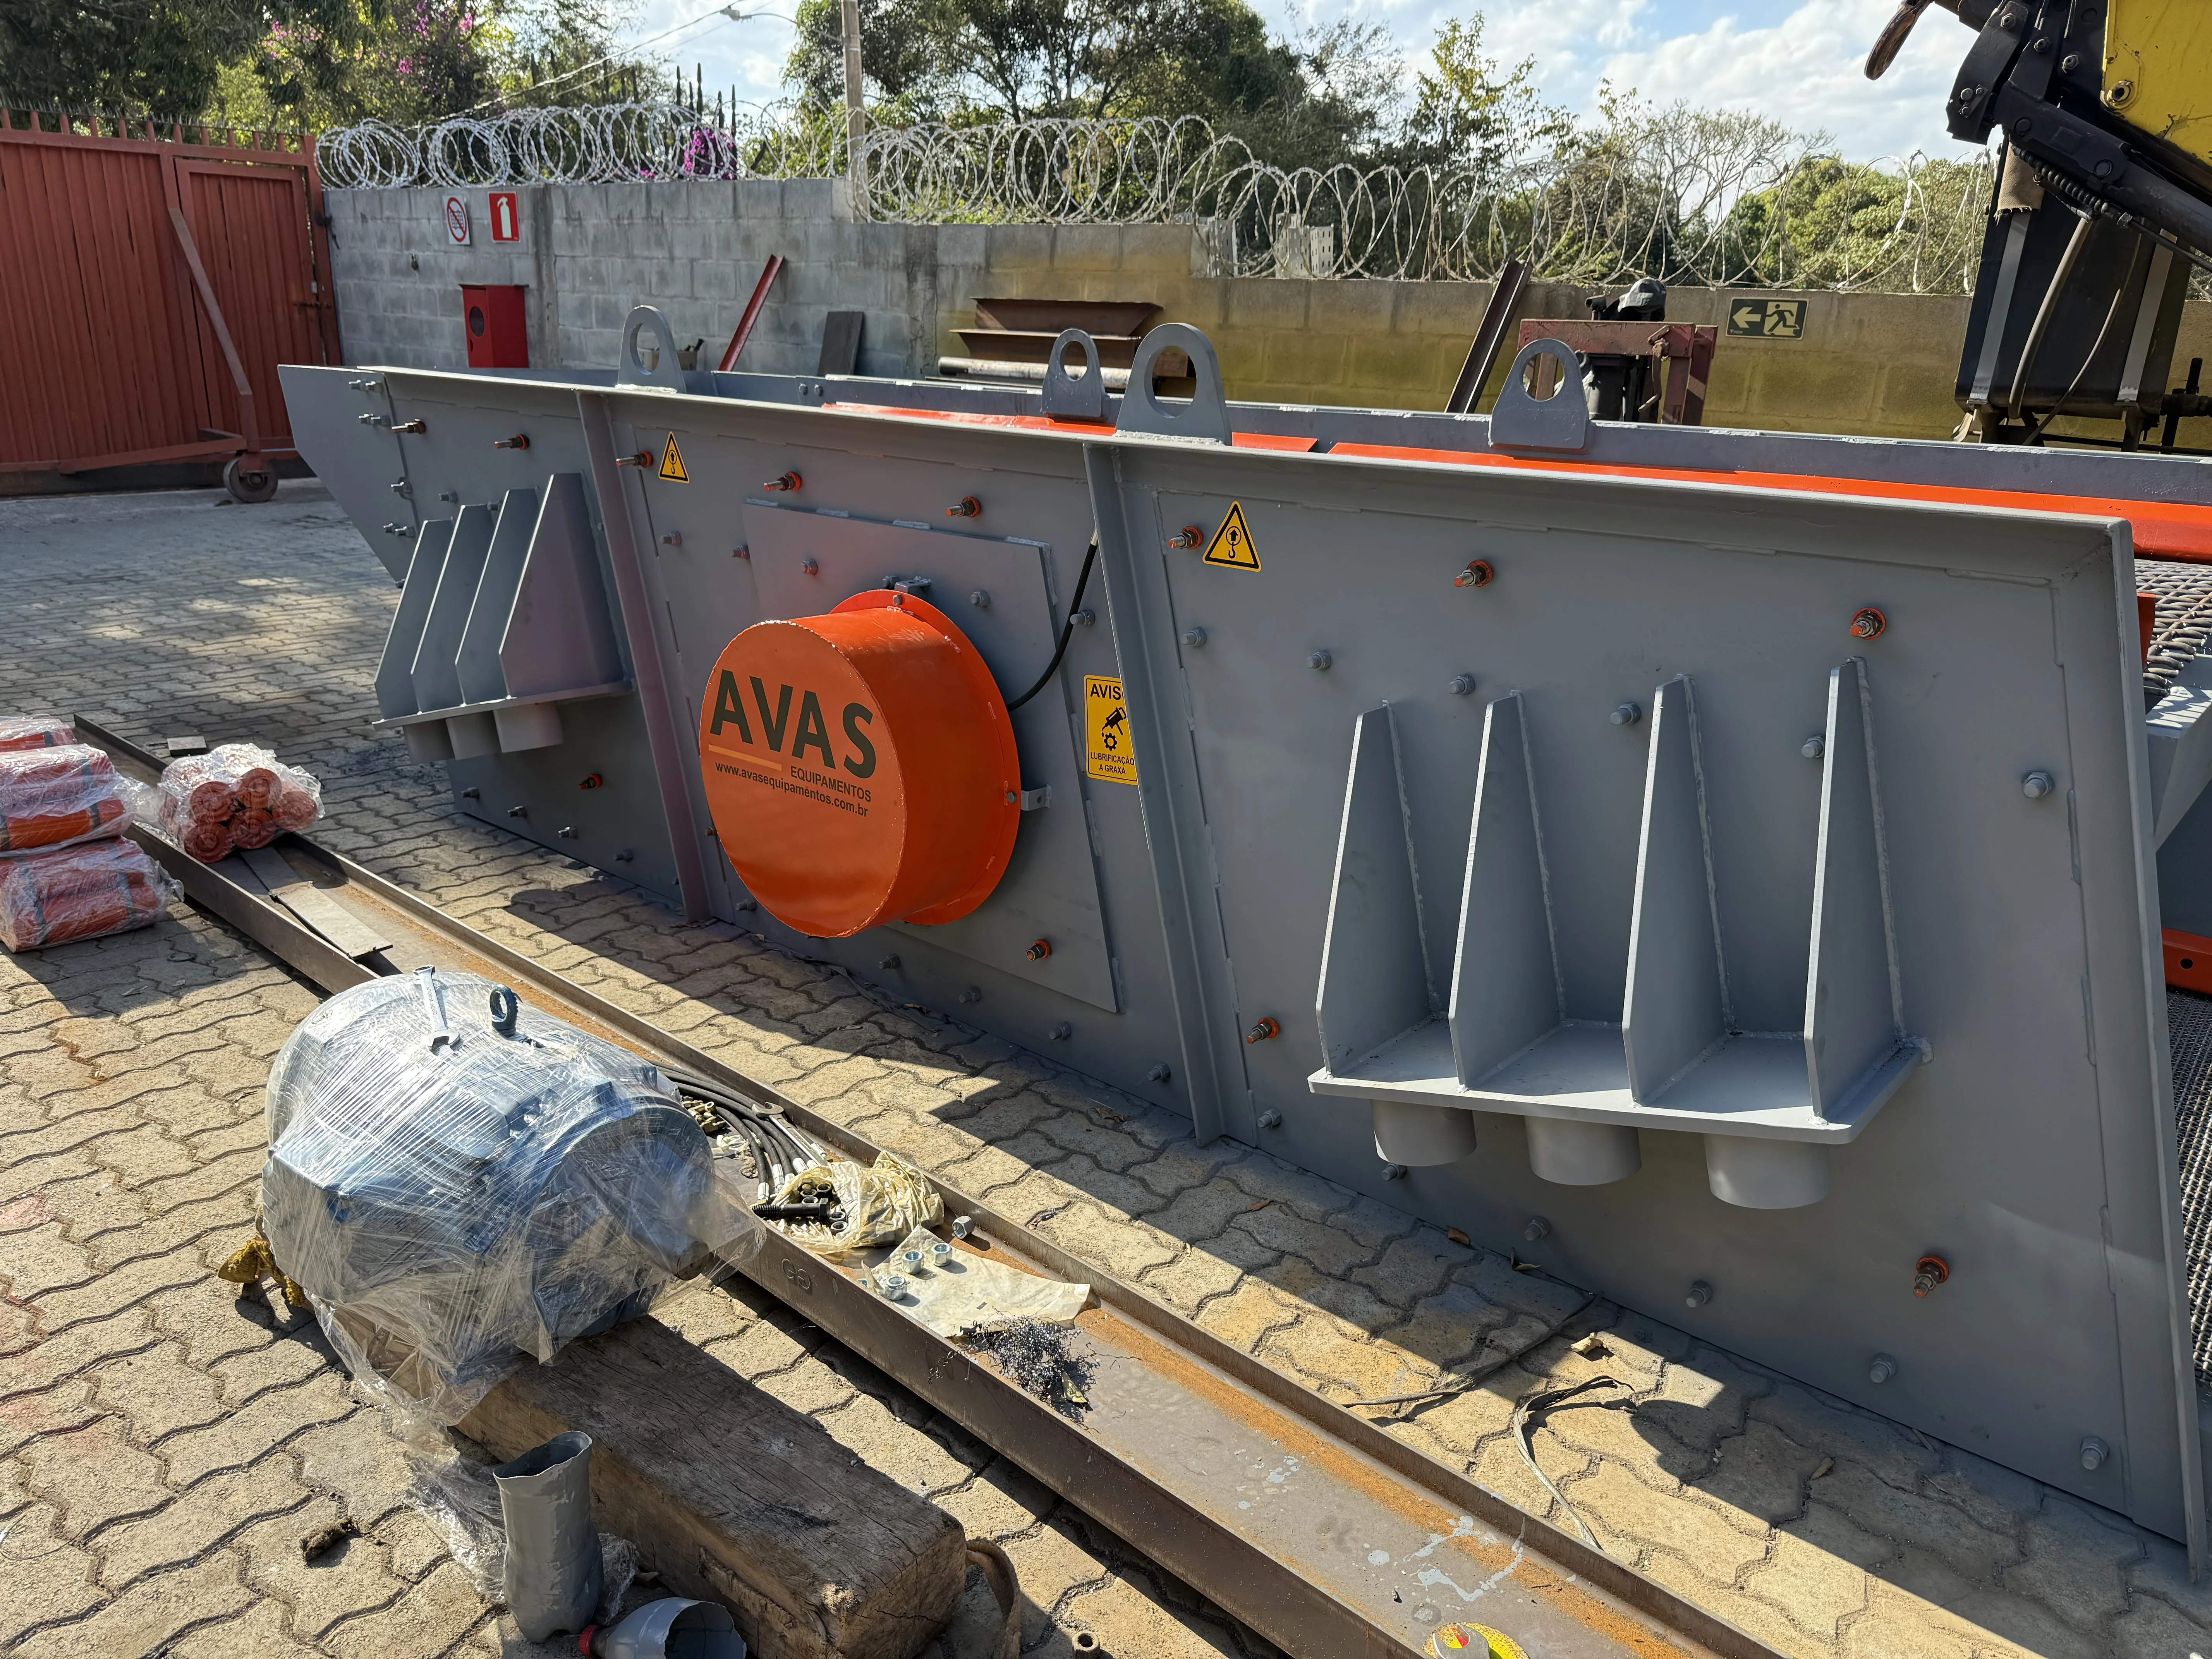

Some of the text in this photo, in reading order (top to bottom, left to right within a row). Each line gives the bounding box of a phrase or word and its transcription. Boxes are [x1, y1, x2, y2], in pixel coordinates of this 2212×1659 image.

[1090, 684, 1124, 700] AVIS
[710, 669, 876, 778] AVAS
[1091, 752, 1134, 765] LUBRIFICAÇÃO
[1105, 765, 1126, 775] GRAXA
[715, 762, 868, 817] www.avasequipamentos.com.br
[791, 766, 871, 802] EQUIPAMENTOS
